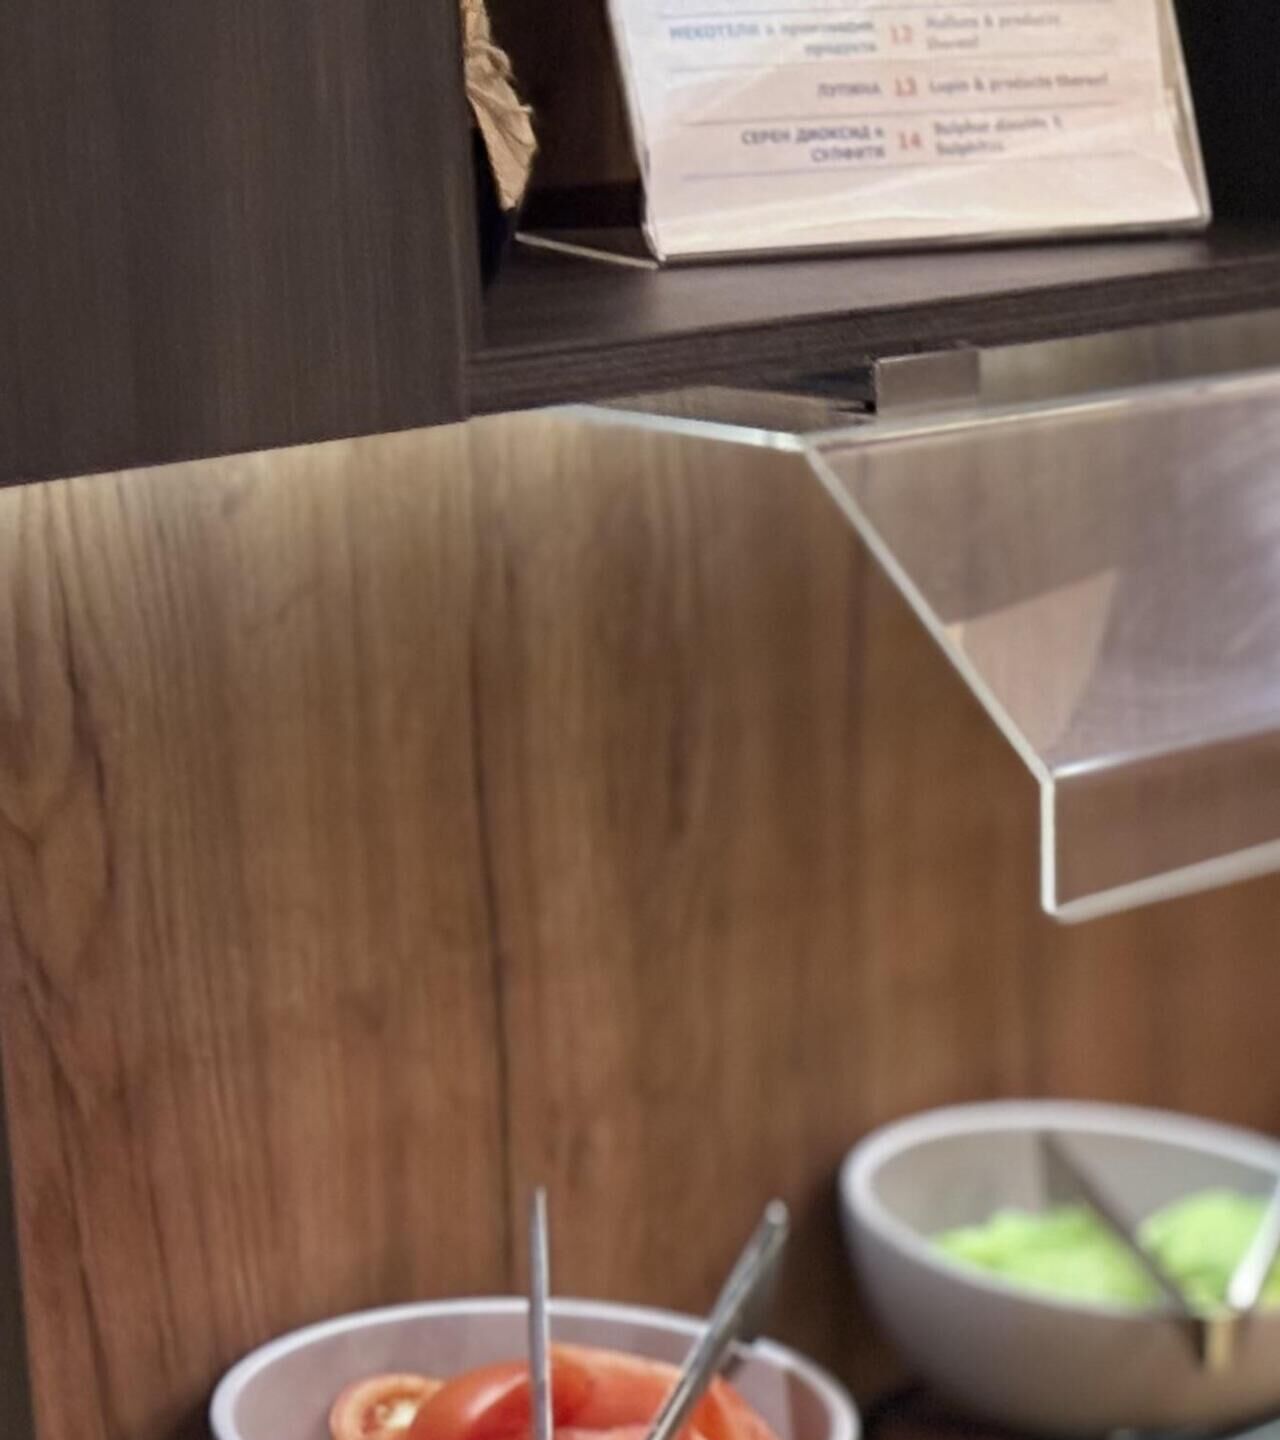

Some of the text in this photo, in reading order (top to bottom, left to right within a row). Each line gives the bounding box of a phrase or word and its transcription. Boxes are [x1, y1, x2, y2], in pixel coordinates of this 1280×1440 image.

[890, 24, 913, 45] 12
[895, 76, 917, 97] 13
[930, 79, 969, 94] Lupin
[989, 76, 1052, 93] products
[741, 129, 791, 145] СЕРЕН
[899, 131, 922, 150] 14
